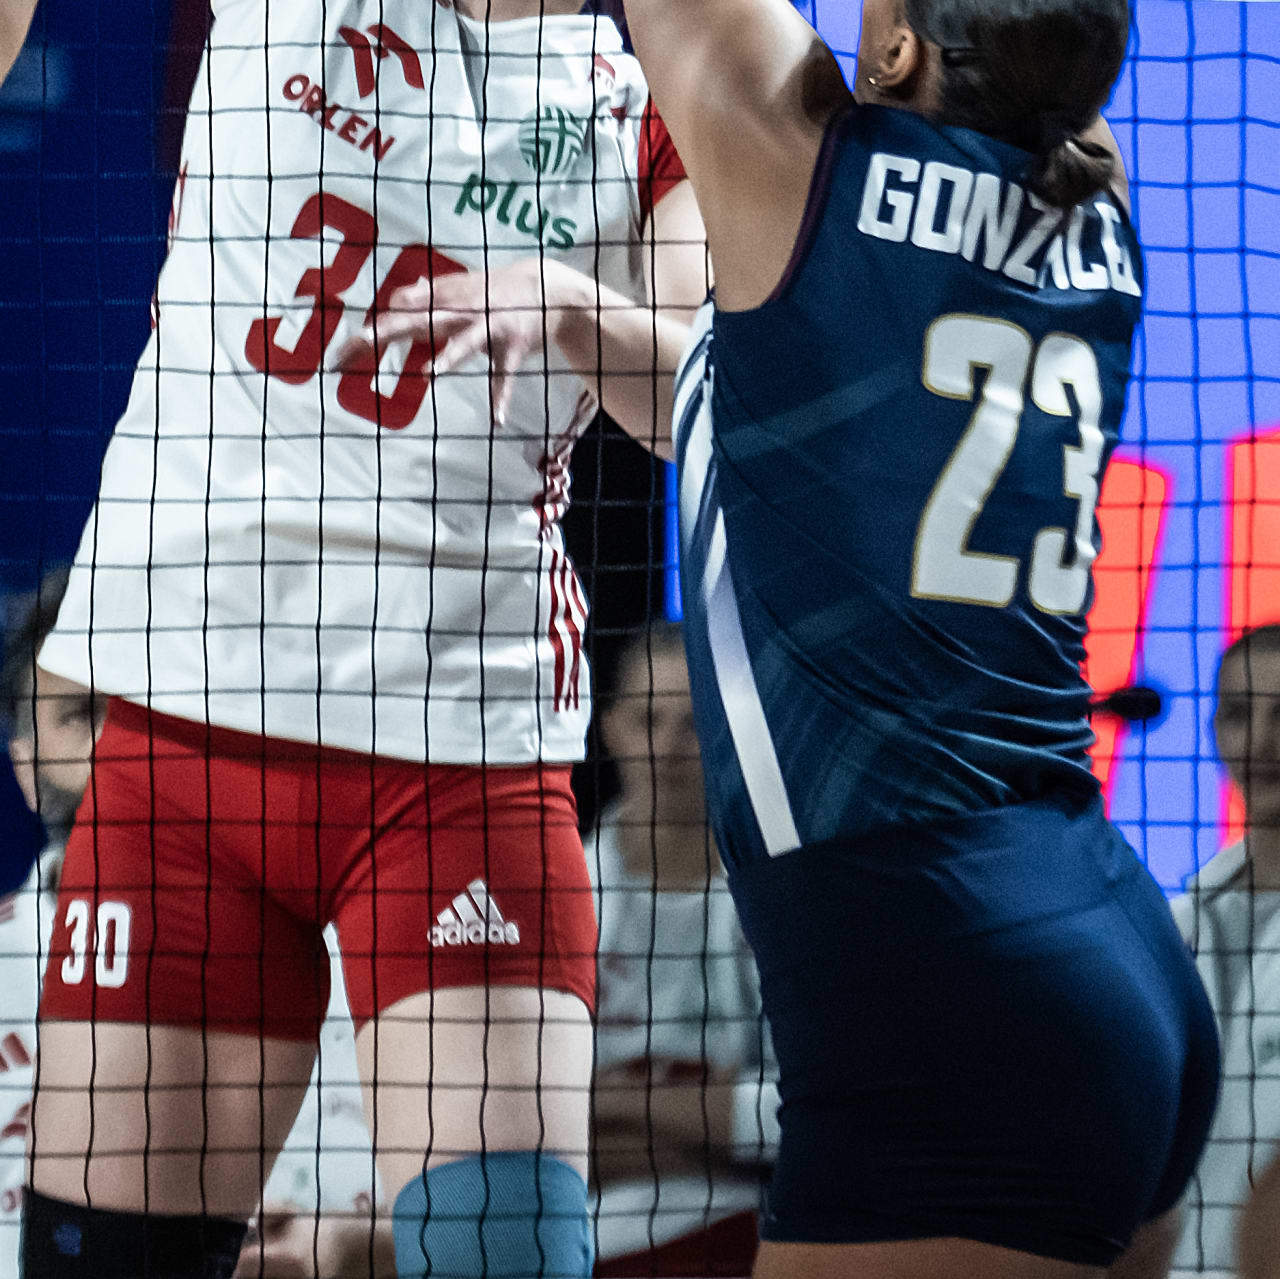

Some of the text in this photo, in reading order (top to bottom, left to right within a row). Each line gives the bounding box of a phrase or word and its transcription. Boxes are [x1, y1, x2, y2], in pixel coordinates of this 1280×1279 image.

[282, 74, 396, 162] ORLEN
[454, 172, 579, 251] plus
[243, 191, 470, 431] 30
[909, 311, 1104, 616] 23
[60, 899, 132, 988] 30
[426, 921, 520, 948] adidas
